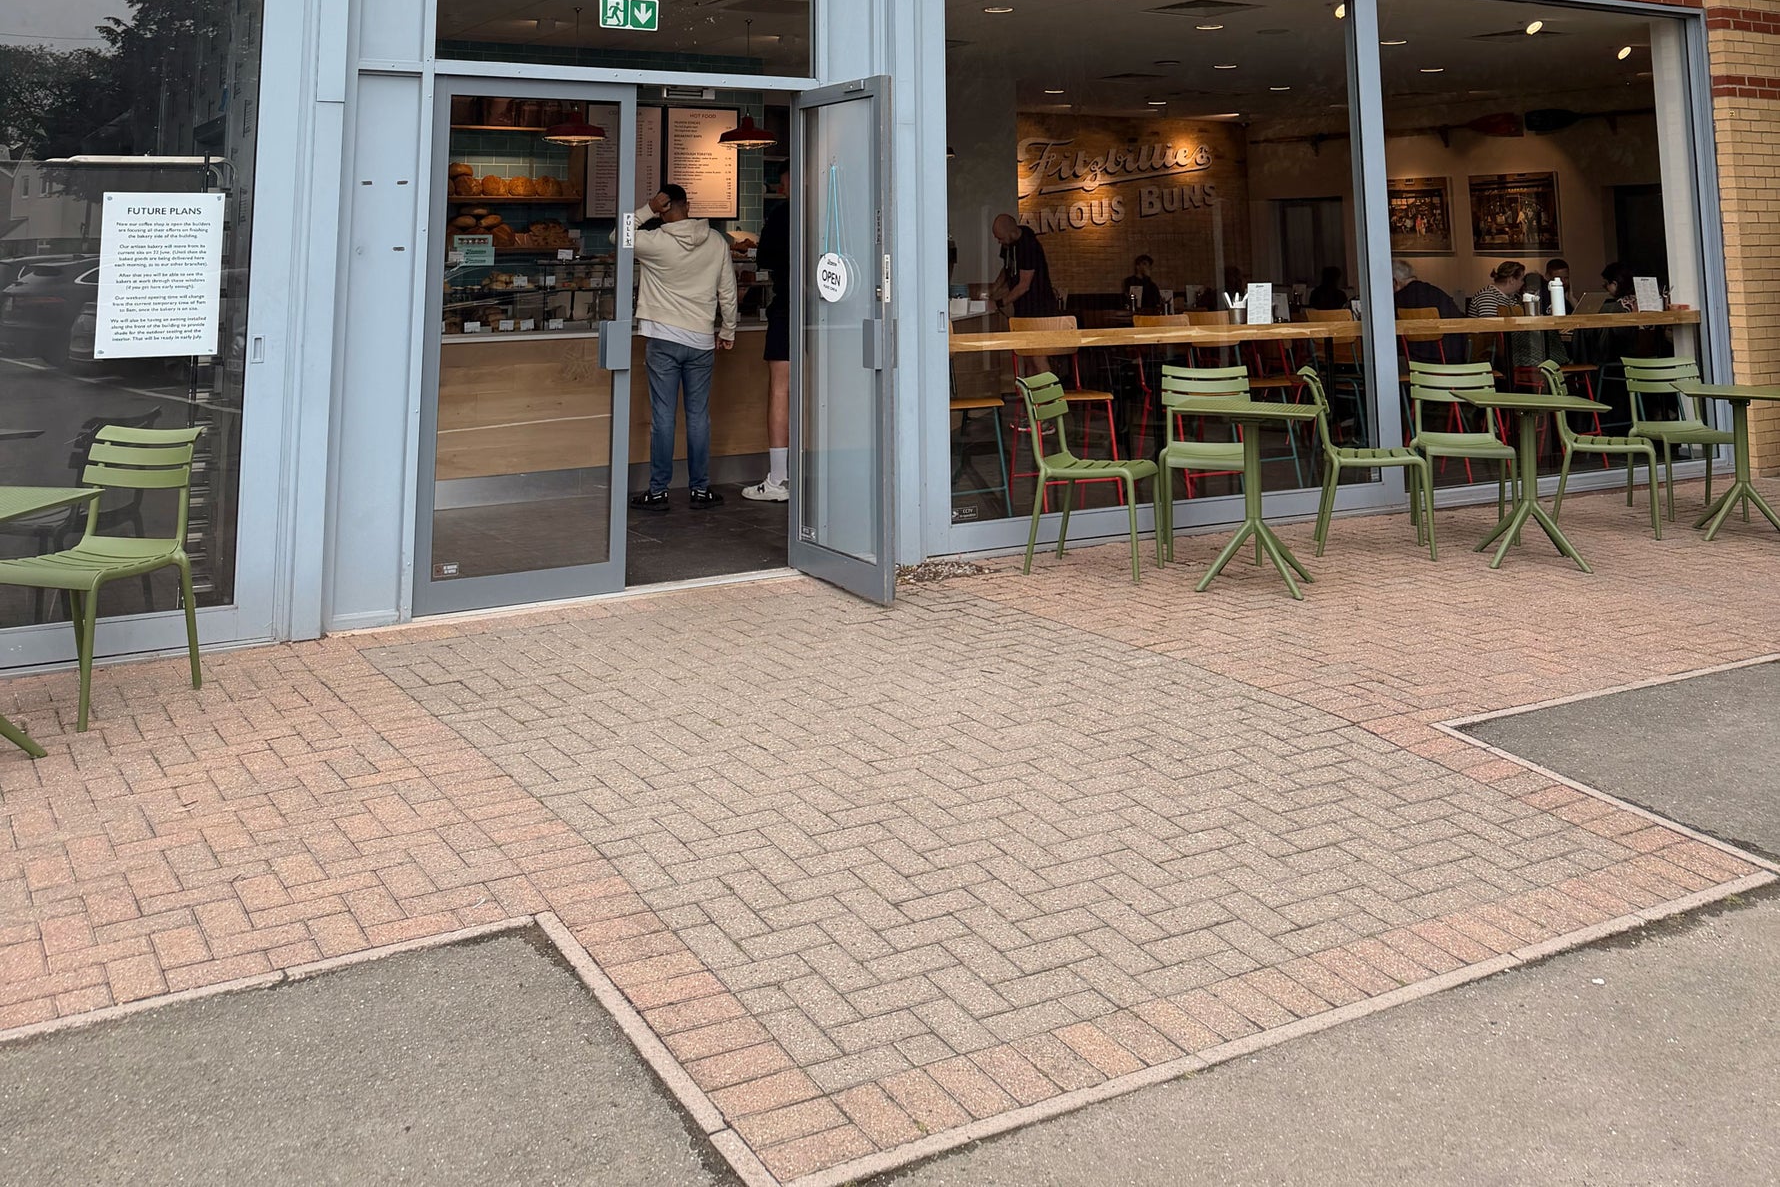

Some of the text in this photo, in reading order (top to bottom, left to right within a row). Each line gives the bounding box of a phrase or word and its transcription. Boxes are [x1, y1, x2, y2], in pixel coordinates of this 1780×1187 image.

[1019, 183, 1216, 236] AMOUS BUNS
[822, 270, 841, 286] OPEN
